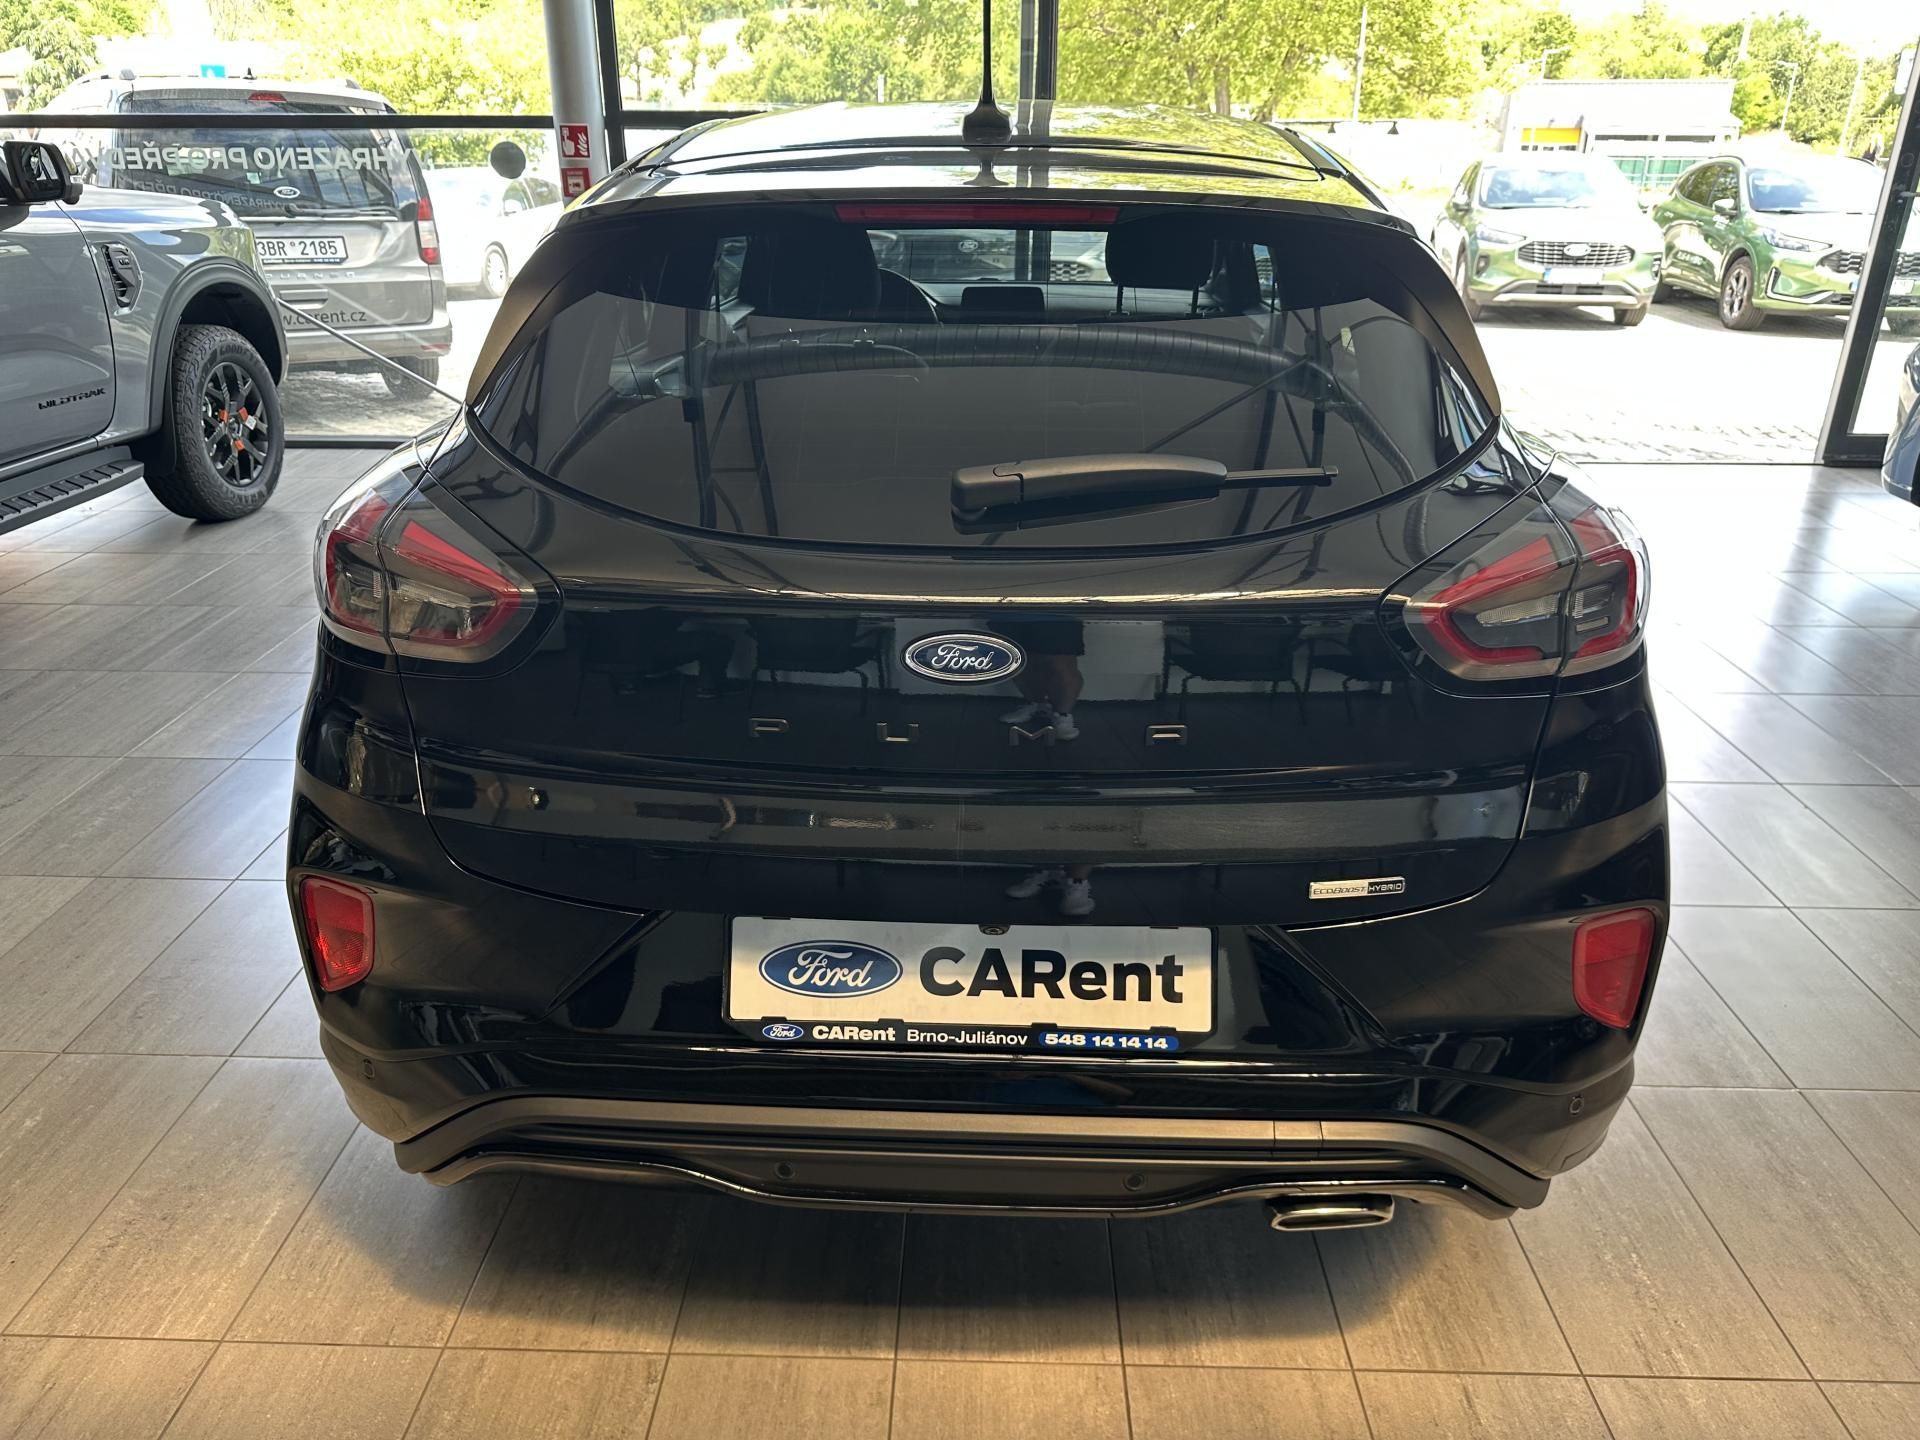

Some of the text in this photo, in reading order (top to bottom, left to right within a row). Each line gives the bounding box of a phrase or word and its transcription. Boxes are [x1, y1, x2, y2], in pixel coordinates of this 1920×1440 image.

[258, 240, 338, 257] 3BR 2185
[38, 388, 106, 410] WILDTRAK
[931, 643, 995, 670] Ford
[748, 717, 1189, 746] PUMA
[1368, 883, 1402, 892] HYBRID
[787, 946, 1184, 1004] Ford CARent
[769, 1025, 796, 1038] Ford
[812, 1025, 896, 1041] CARent
[906, 1028, 1028, 1046] Brno-Juliánov
[1044, 1033, 1087, 1046] 548
